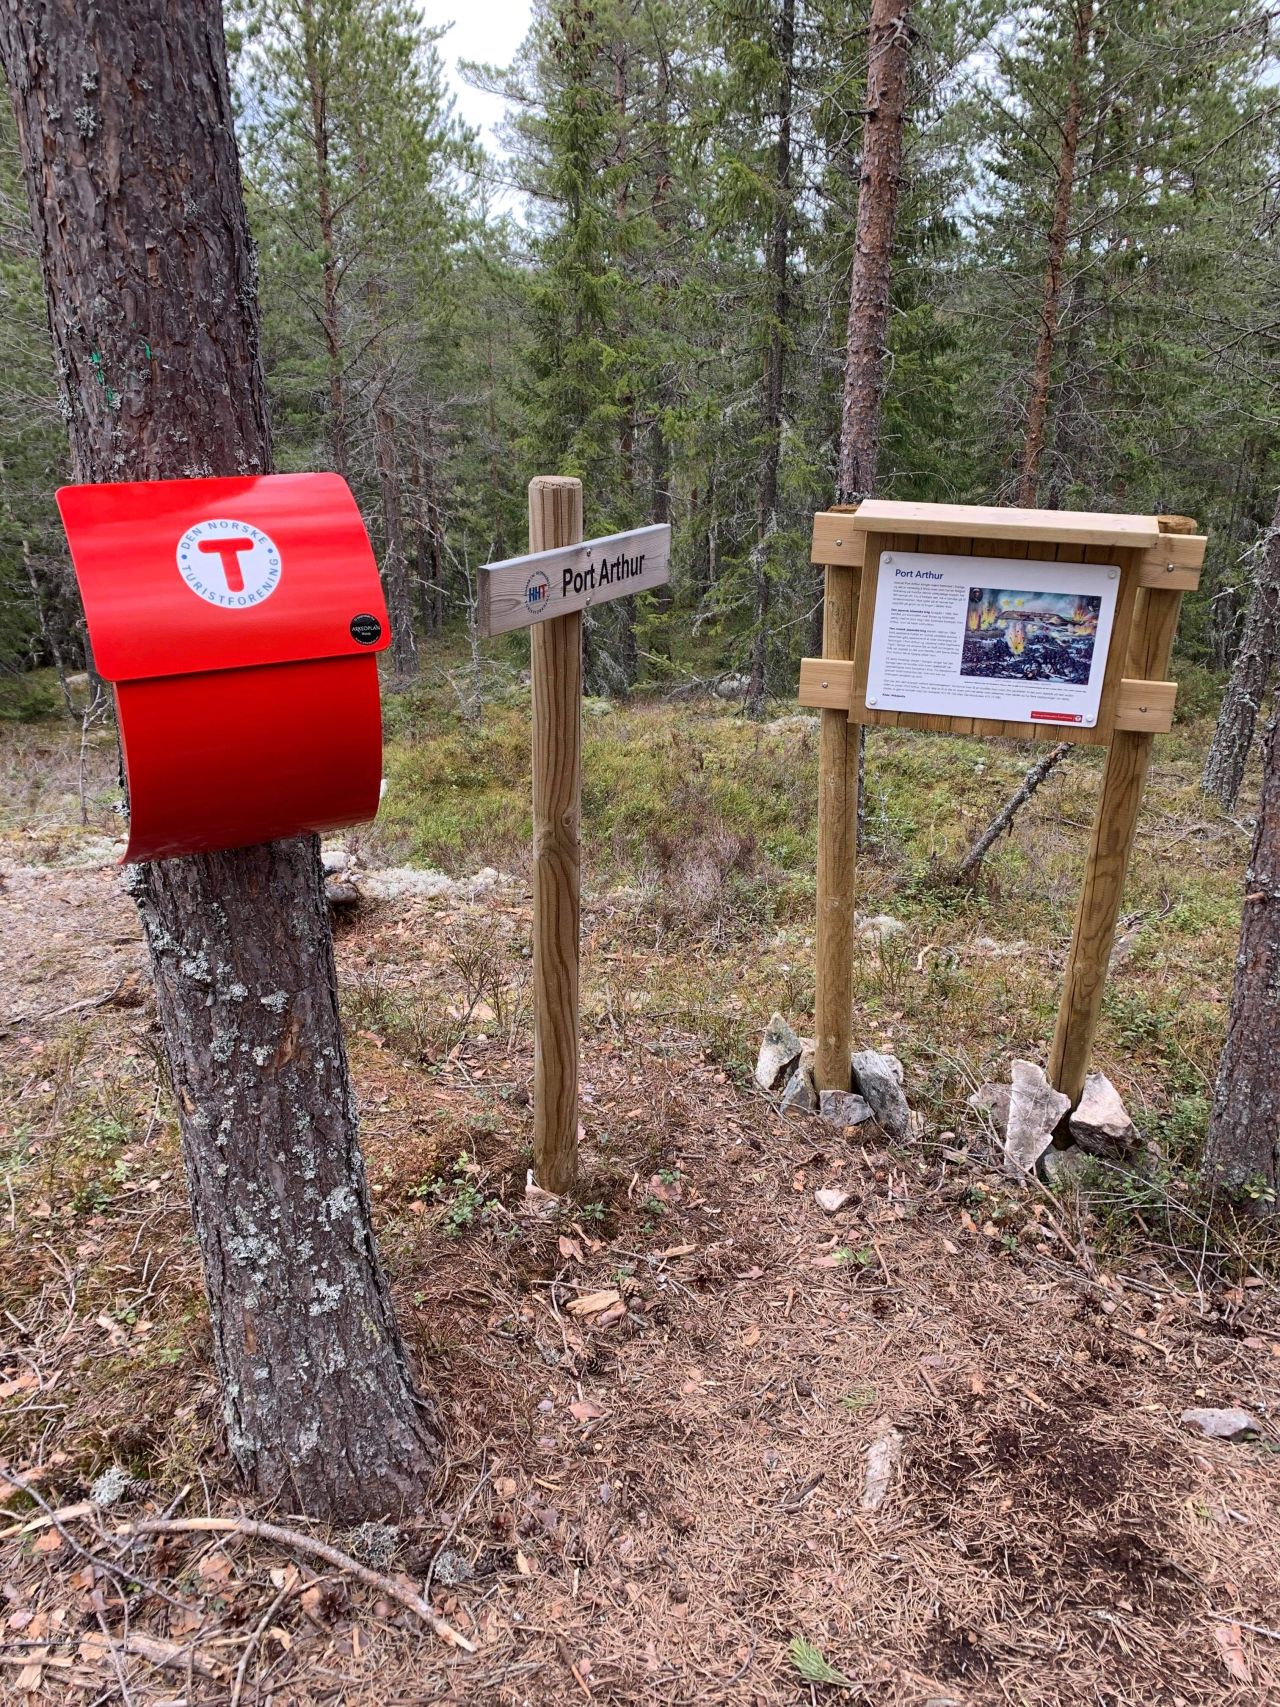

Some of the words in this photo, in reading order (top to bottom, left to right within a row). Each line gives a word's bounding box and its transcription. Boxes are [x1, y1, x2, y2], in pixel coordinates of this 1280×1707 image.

[181, 527, 203, 551] DEN
[207, 520, 268, 545] NORSKE
[181, 557, 280, 606] TURISTFORENING
[198, 537, 254, 593] T
[562, 563, 596, 598] Port
[599, 553, 646, 587] Arthur
[895, 568, 913, 578] Port
[915, 570, 944, 580] Arthur
[528, 583, 548, 603] HHT
